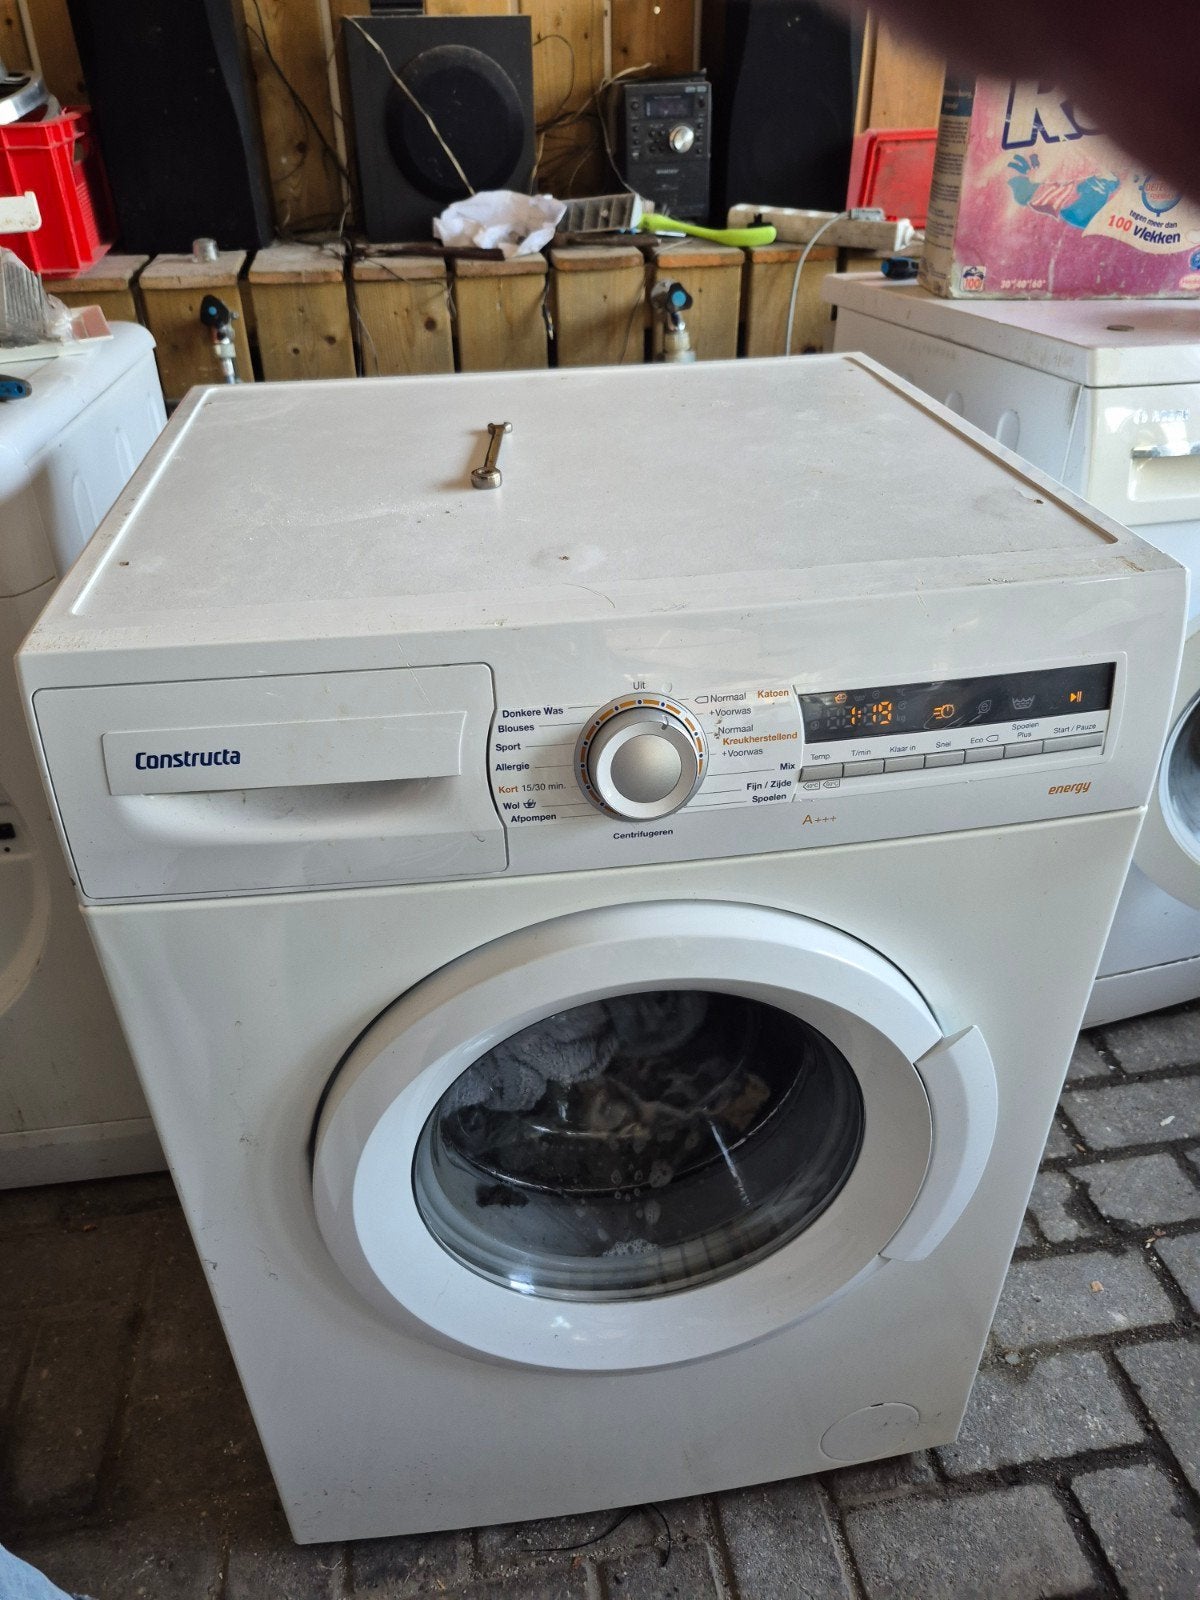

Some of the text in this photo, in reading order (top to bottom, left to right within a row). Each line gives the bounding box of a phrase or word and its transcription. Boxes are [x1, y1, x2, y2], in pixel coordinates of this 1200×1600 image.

[1129, 209, 1147, 222] tegen
[1147, 219, 1163, 228] meer
[1108, 214, 1181, 244] 100 vlekken
[633, 681, 646, 690] Uit
[710, 692, 747, 702] Normaal
[757, 689, 789, 699] Katoen
[502, 706, 564, 719] Donkere Was
[709, 707, 752, 717] +Voorwas
[498, 724, 535, 733] Blouses
[718, 724, 754, 734] Normaal
[1012, 721, 1040, 731] Spoelen
[1053, 726, 1070, 734] Start
[1076, 723, 1097, 731] Pauze
[722, 732, 798, 746] Kreukherstellend
[970, 736, 984, 744] Eco
[495, 743, 521, 752] Sport
[889, 745, 908, 753] Klaar
[935, 741, 952, 749] Snel
[722, 748, 763, 757] +Voorwas
[810, 753, 831, 761] Temp
[851, 749, 871, 757] T/min
[135, 749, 240, 770] Constructa
[495, 762, 530, 772] Allergie
[780, 762, 796, 770] Mix
[498, 782, 567, 794] Kort 15/30 min.
[746, 782, 763, 792] Fijn
[770, 779, 792, 790] Zijde
[1048, 781, 1092, 795] energy
[752, 793, 787, 803] Spoelen
[503, 801, 520, 810] Wol
[510, 813, 557, 823] Afpompen
[802, 814, 837, 825] A+++
[613, 828, 674, 840] Centrifugeren
